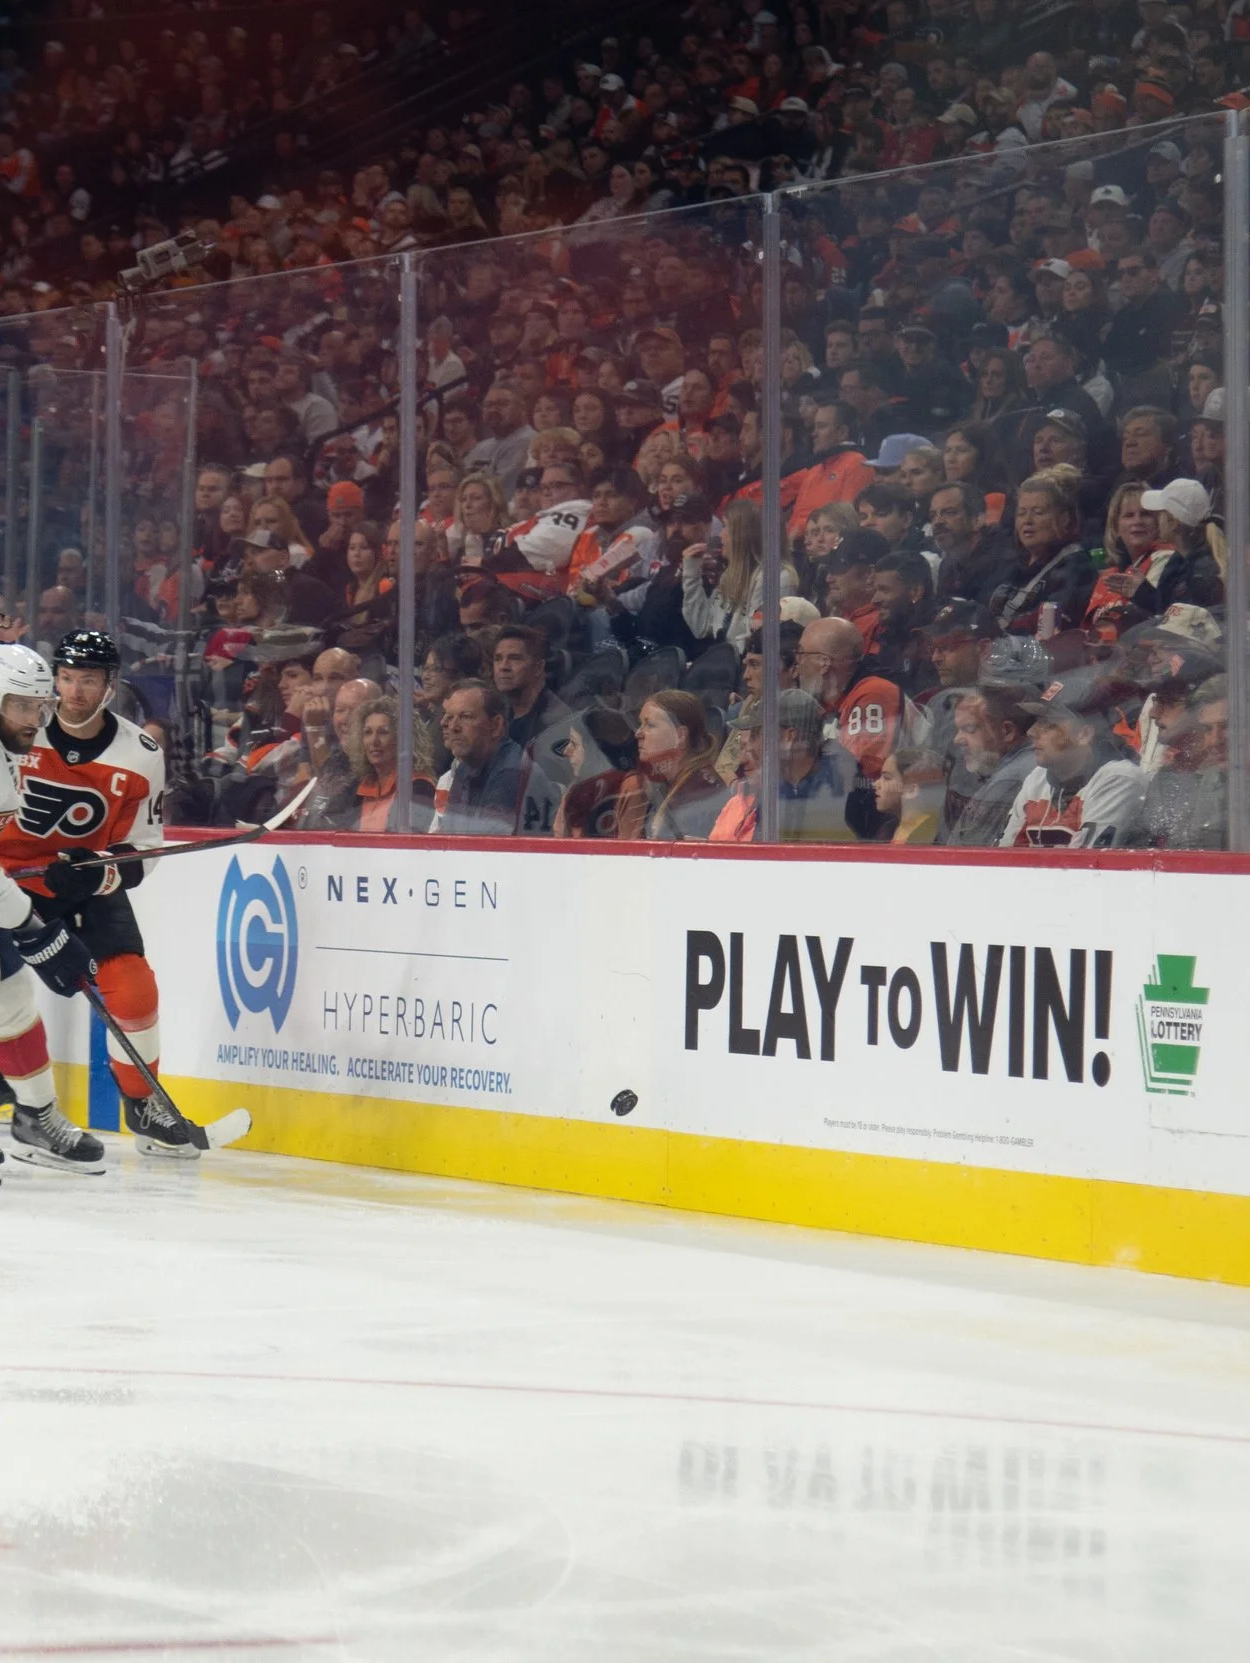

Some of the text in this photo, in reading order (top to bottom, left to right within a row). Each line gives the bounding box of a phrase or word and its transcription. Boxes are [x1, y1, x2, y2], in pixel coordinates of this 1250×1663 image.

[848, 703, 884, 736] 88
[111, 771, 128, 797] C
[147, 790, 165, 825] 14
[323, 990, 498, 1045] HYPERBARIC
[685, 929, 855, 1062] PLAY
[930, 941, 1114, 1088] WIN!
[1151, 1005, 1203, 1021] PENNSYLVANIA
[1151, 1020, 1203, 1042] LOTTERY
[217, 1043, 512, 1095] AMPLIFY YOUR HEALING. ACCELERATE YOUR RECOVERY.
